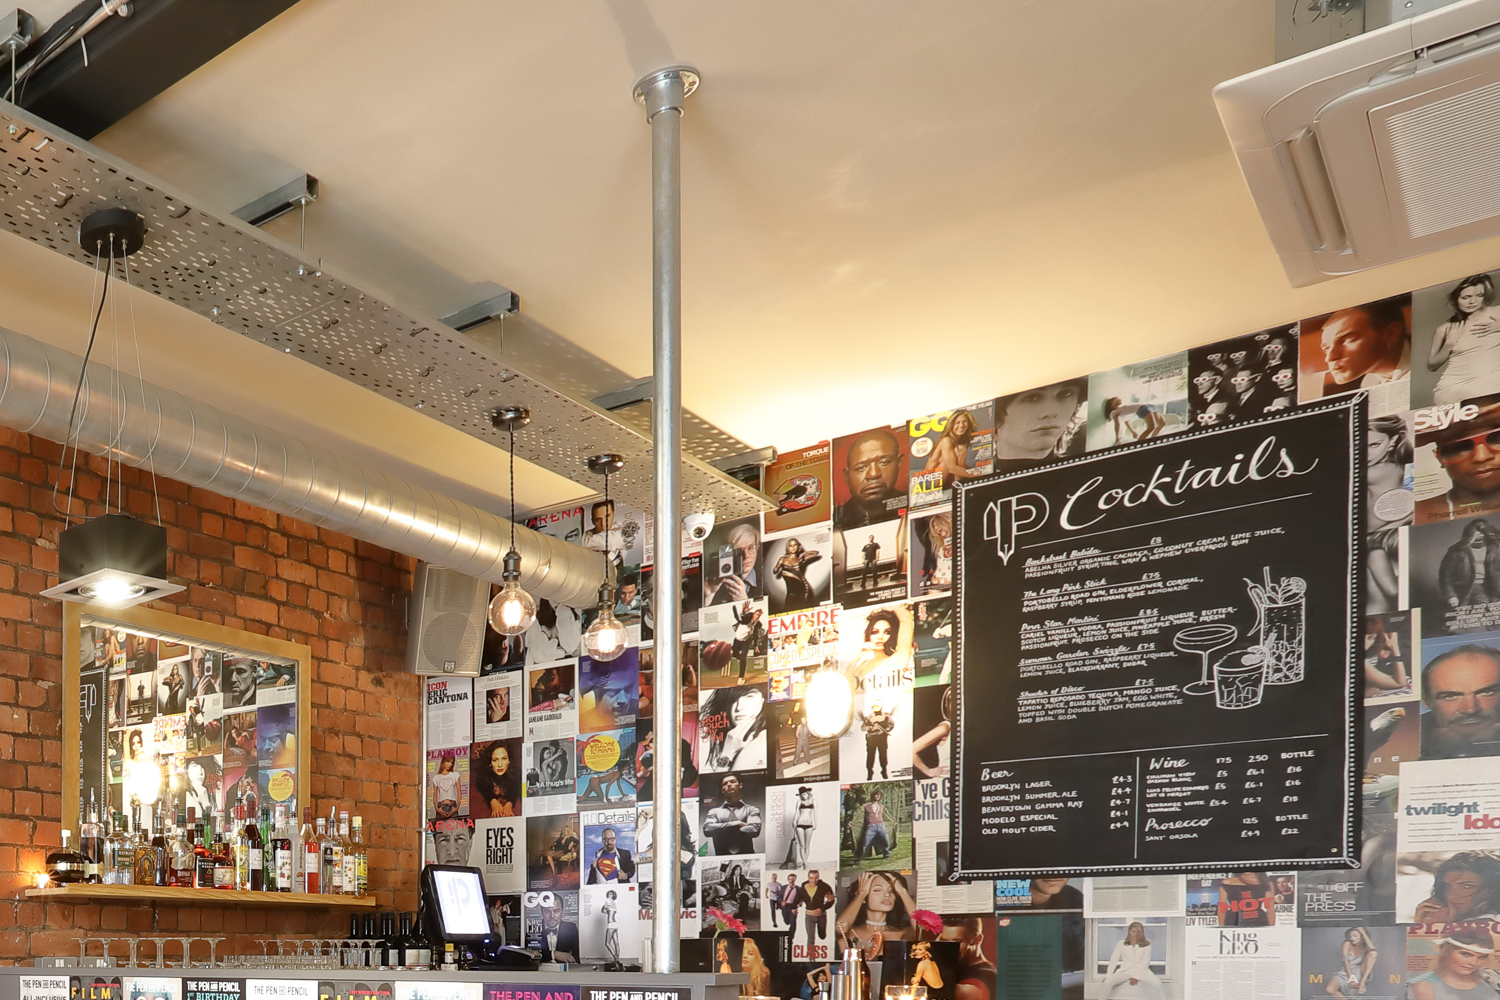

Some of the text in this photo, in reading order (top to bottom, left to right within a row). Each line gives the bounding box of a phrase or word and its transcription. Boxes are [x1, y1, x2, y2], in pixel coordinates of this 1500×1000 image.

[1414, 401, 1479, 430] Style
[802, 446, 829, 458] TORQUE
[911, 472, 943, 484] BARES
[1059, 436, 1319, 530] Cocktails
[912, 479, 943, 494] ALL!
[768, 608, 840, 634] EMPIRE
[427, 681, 448, 691] ICON
[427, 689, 448, 698] ERIC
[427, 692, 468, 705] CANTONA
[427, 747, 468, 759] PLAYBOY
[1149, 757, 1189, 770] Wine
[1248, 755, 1268, 763] 250
[1281, 750, 1315, 759] BOTTLE
[981, 768, 1014, 781] Beer
[1217, 770, 1228, 778] £5
[982, 781, 1052, 792] BROOKLYN LAGER
[982, 794, 1020, 803] BROOKLYN
[1025, 791, 1060, 799] SUMMER
[982, 805, 1031, 814] BEAVERTOWN
[1035, 802, 1064, 810] GAMMA
[1405, 802, 1480, 817] twilight
[427, 818, 475, 832] ARENA
[982, 814, 1058, 825] MODELO ESPECIAL
[1145, 817, 1213, 831] Prosecco
[1275, 814, 1309, 822] BOTTLE
[486, 827, 514, 848] EYES
[486, 848, 514, 865] RIGHT
[996, 879, 1031, 888] NEW
[1334, 882, 1364, 892] OFF
[996, 888, 1031, 896] COOL
[1305, 892, 1332, 902] THE
[524, 891, 555, 908] GQ
[1219, 897, 1275, 913] HOT
[1305, 901, 1356, 912] PRESS
[1186, 915, 1218, 926] LIV TYLER
[1219, 930, 1258, 943] King
[793, 944, 828, 960] CLASS
[1219, 942, 1258, 955] LEO
[23, 980, 67, 989] THE PEN PENCIL
[187, 981, 240, 992] THE PEN PENCIL
[71, 987, 111, 1000] FILM
